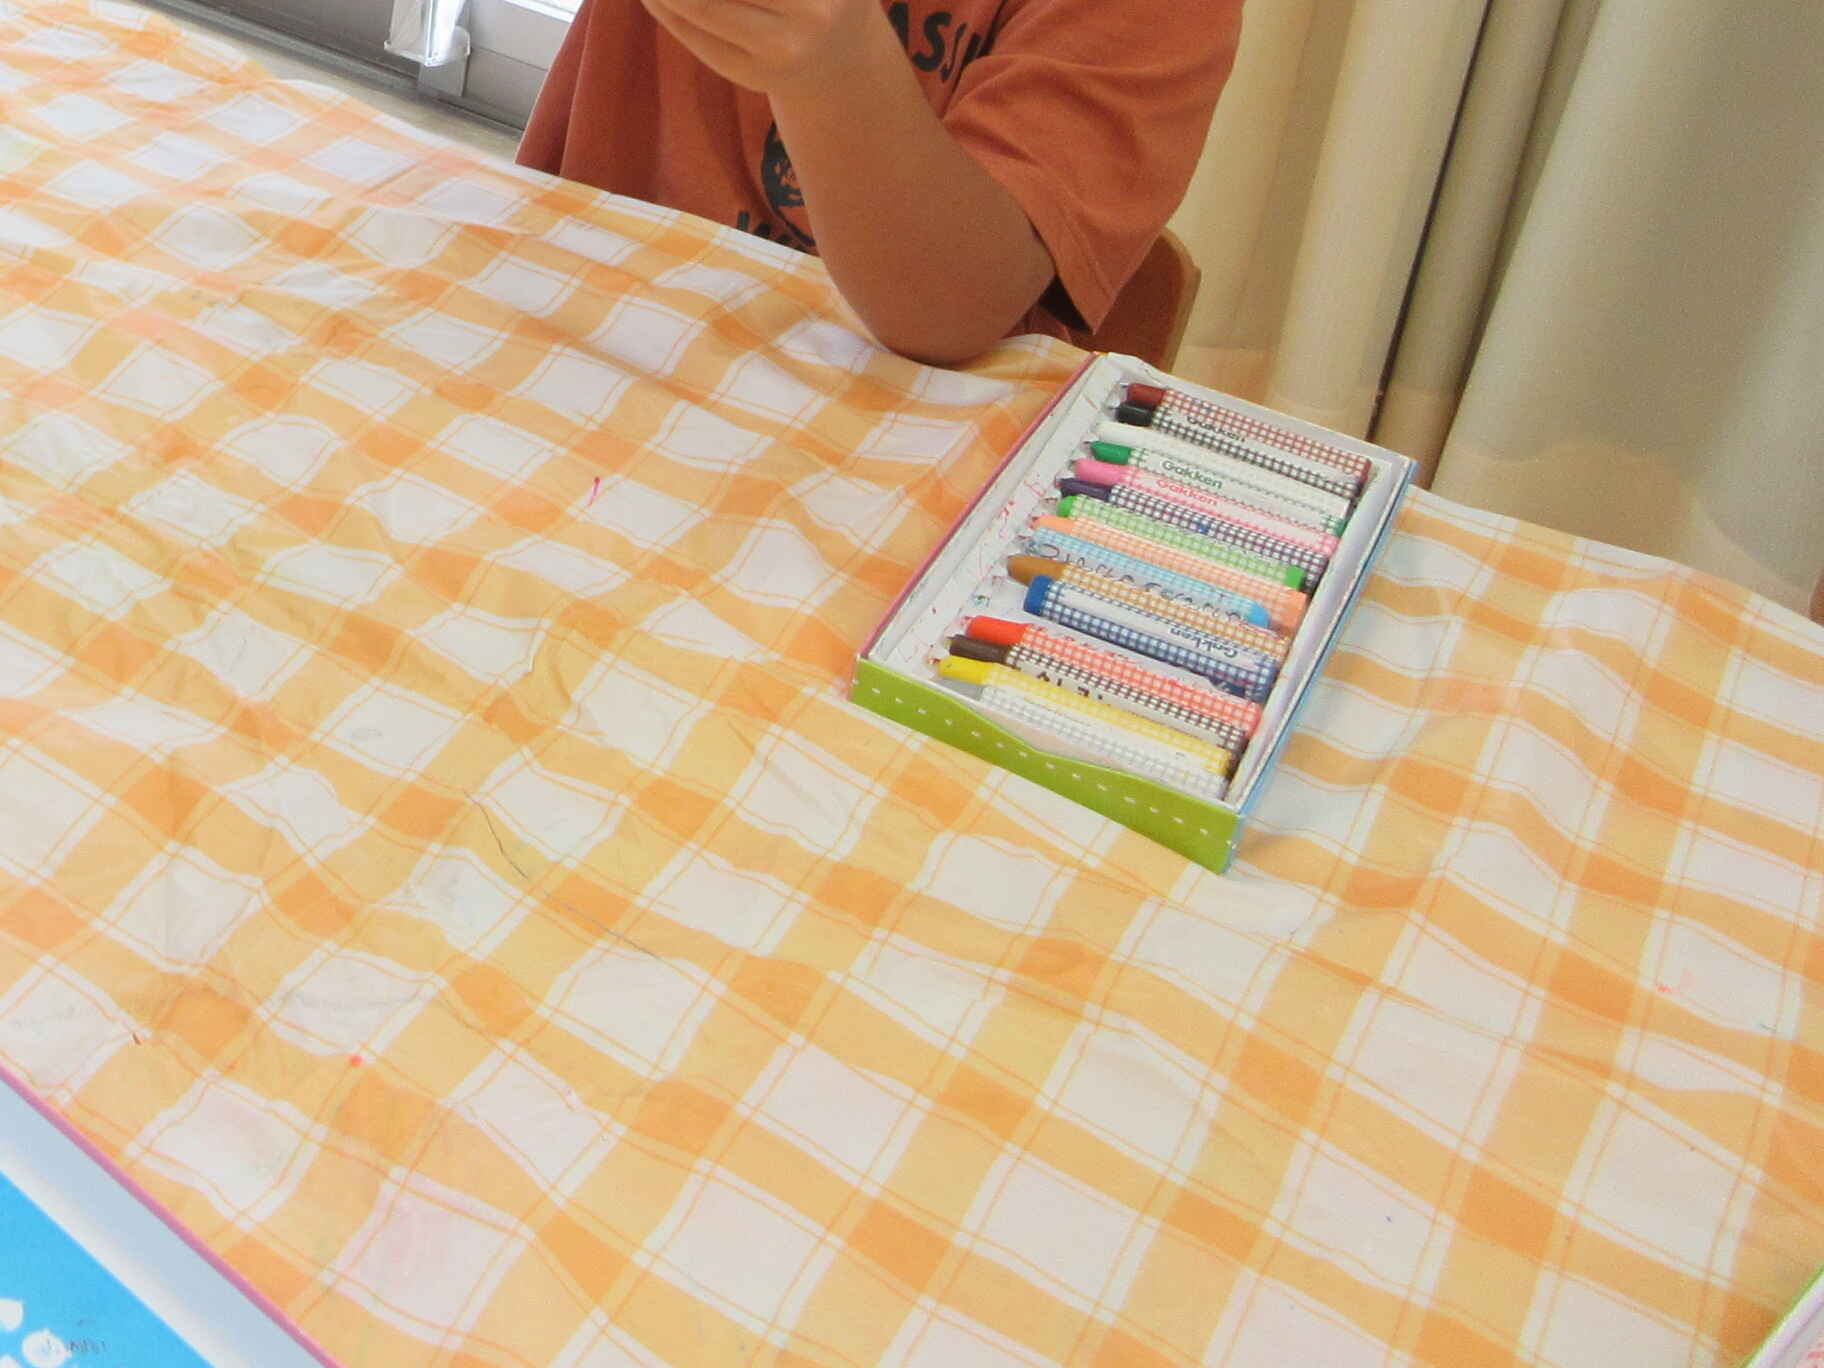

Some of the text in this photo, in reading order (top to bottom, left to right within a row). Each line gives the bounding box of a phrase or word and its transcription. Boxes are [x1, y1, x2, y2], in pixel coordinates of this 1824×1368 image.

[1162, 460, 1222, 489] Gakken
[1157, 479, 1217, 506] Gakken
[1169, 626, 1238, 658] Gakken
